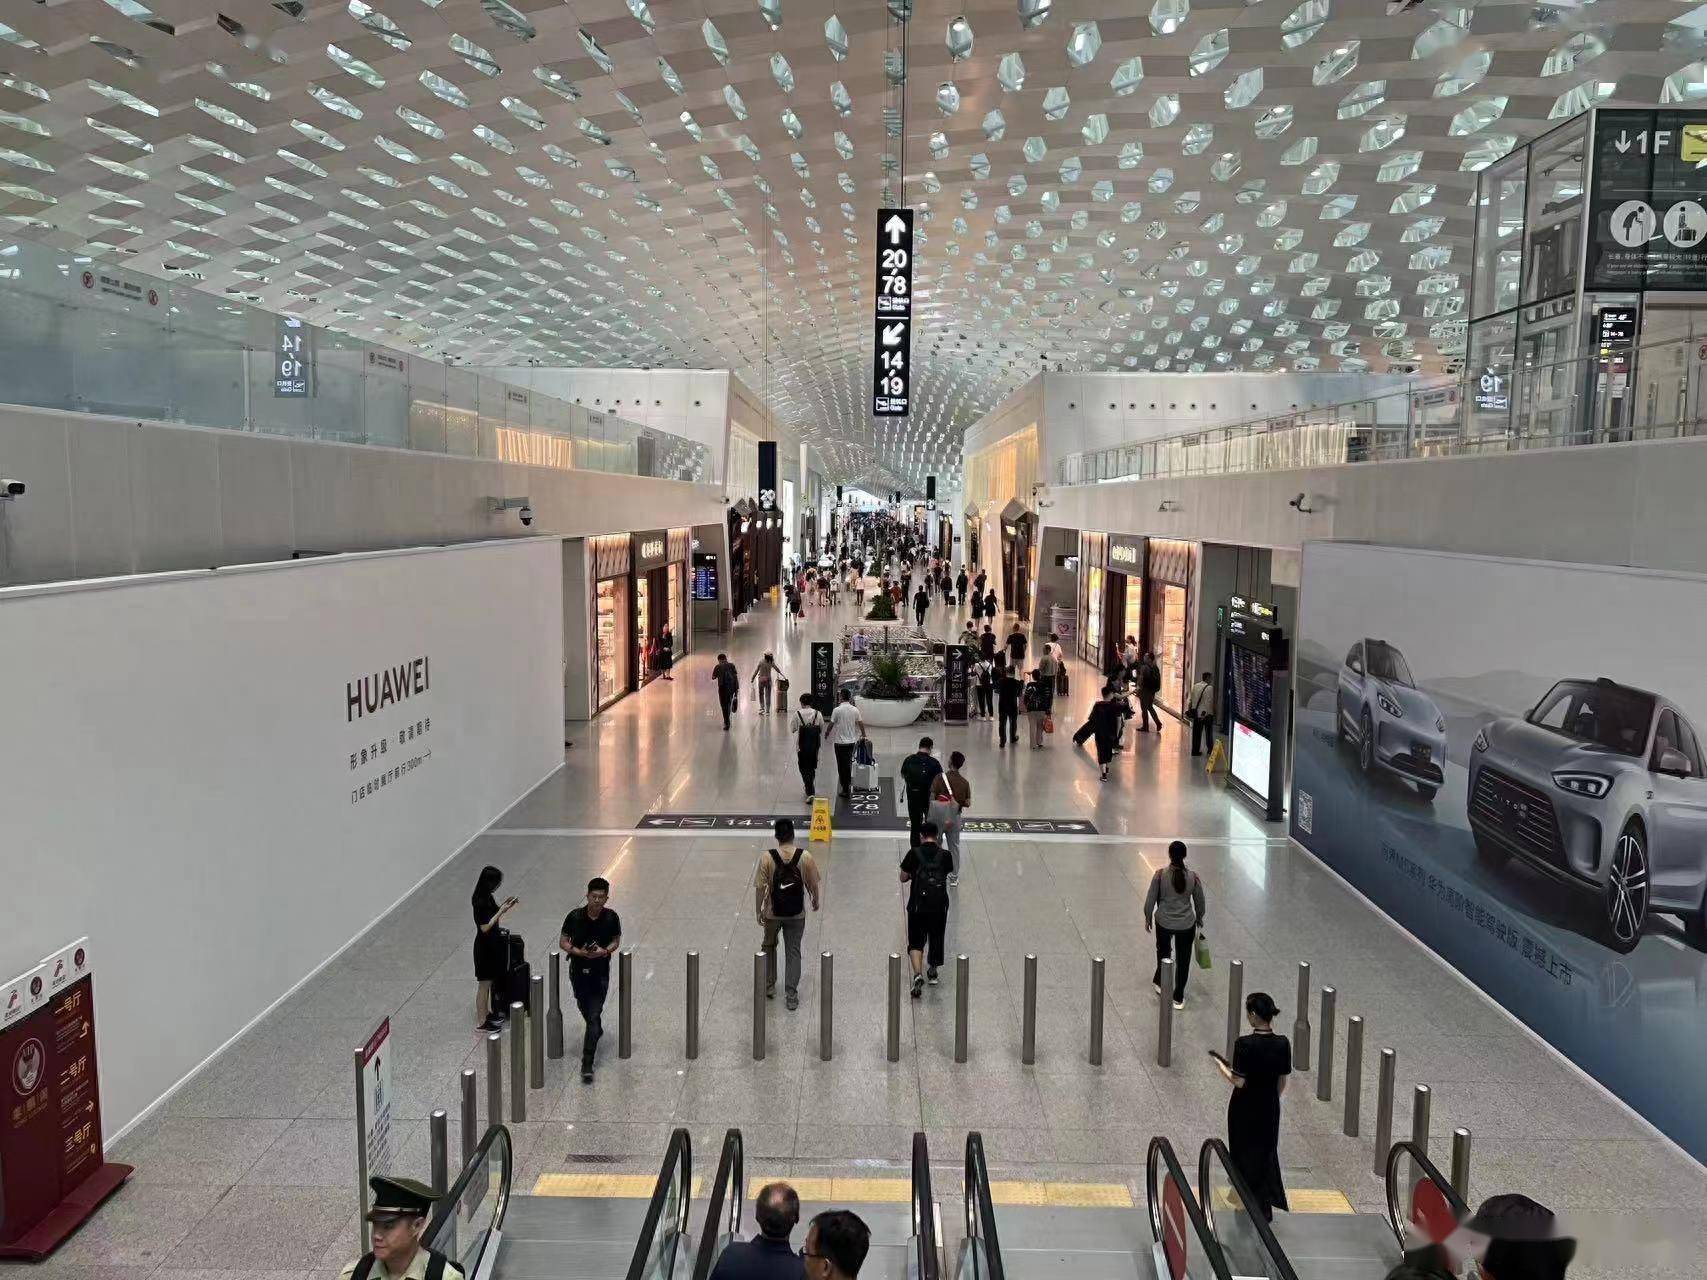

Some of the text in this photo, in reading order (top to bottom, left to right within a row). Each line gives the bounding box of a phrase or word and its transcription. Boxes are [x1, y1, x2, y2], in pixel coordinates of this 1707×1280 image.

[1636, 130, 1671, 154] 1F
[882, 249, 907, 268] 20
[882, 275, 907, 294] 78
[881, 351, 903, 368] 14
[881, 377, 903, 395] 19
[346, 656, 429, 722] HUAWEI
[54, 990, 82, 1015] 一号厅
[60, 1056, 87, 1085] 二号厅
[65, 1122, 91, 1153] 三号厅
